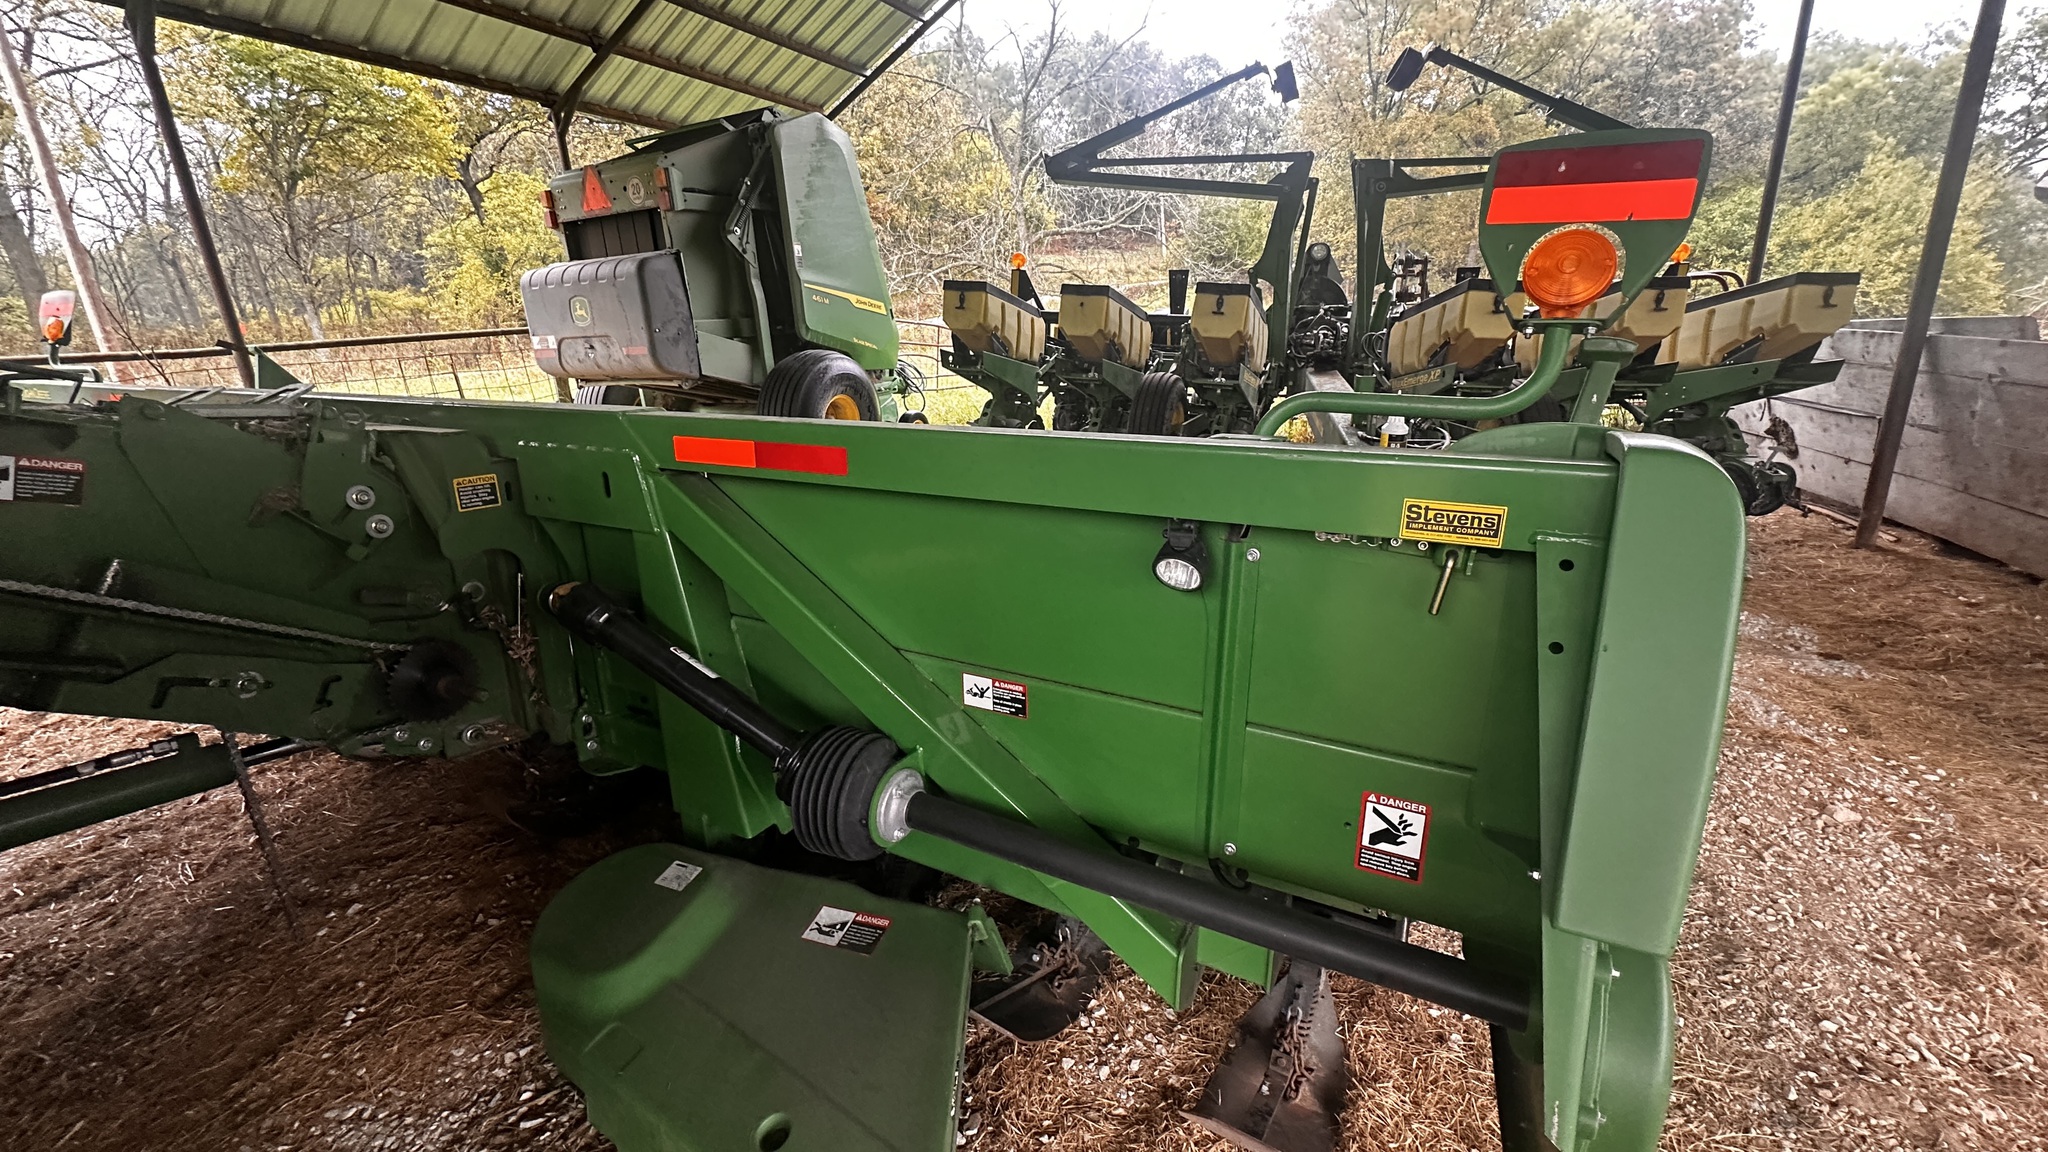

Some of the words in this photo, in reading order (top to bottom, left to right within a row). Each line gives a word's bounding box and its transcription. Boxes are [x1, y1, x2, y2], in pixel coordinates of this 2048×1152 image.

[631, 182, 640, 196] 20
[855, 298, 868, 306] JOHN
[868, 301, 882, 310] DEERE
[32, 459, 83, 471] DANGER
[462, 476, 495, 485] CAUTION
[1406, 504, 1496, 528] Stevens
[1409, 522, 1454, 532] IMPLEMENT
[1456, 527, 1495, 536] COMPANY
[1000, 683, 1024, 692] DANGER
[1380, 796, 1426, 814] DANGER
[863, 915, 890, 926] DANGER
